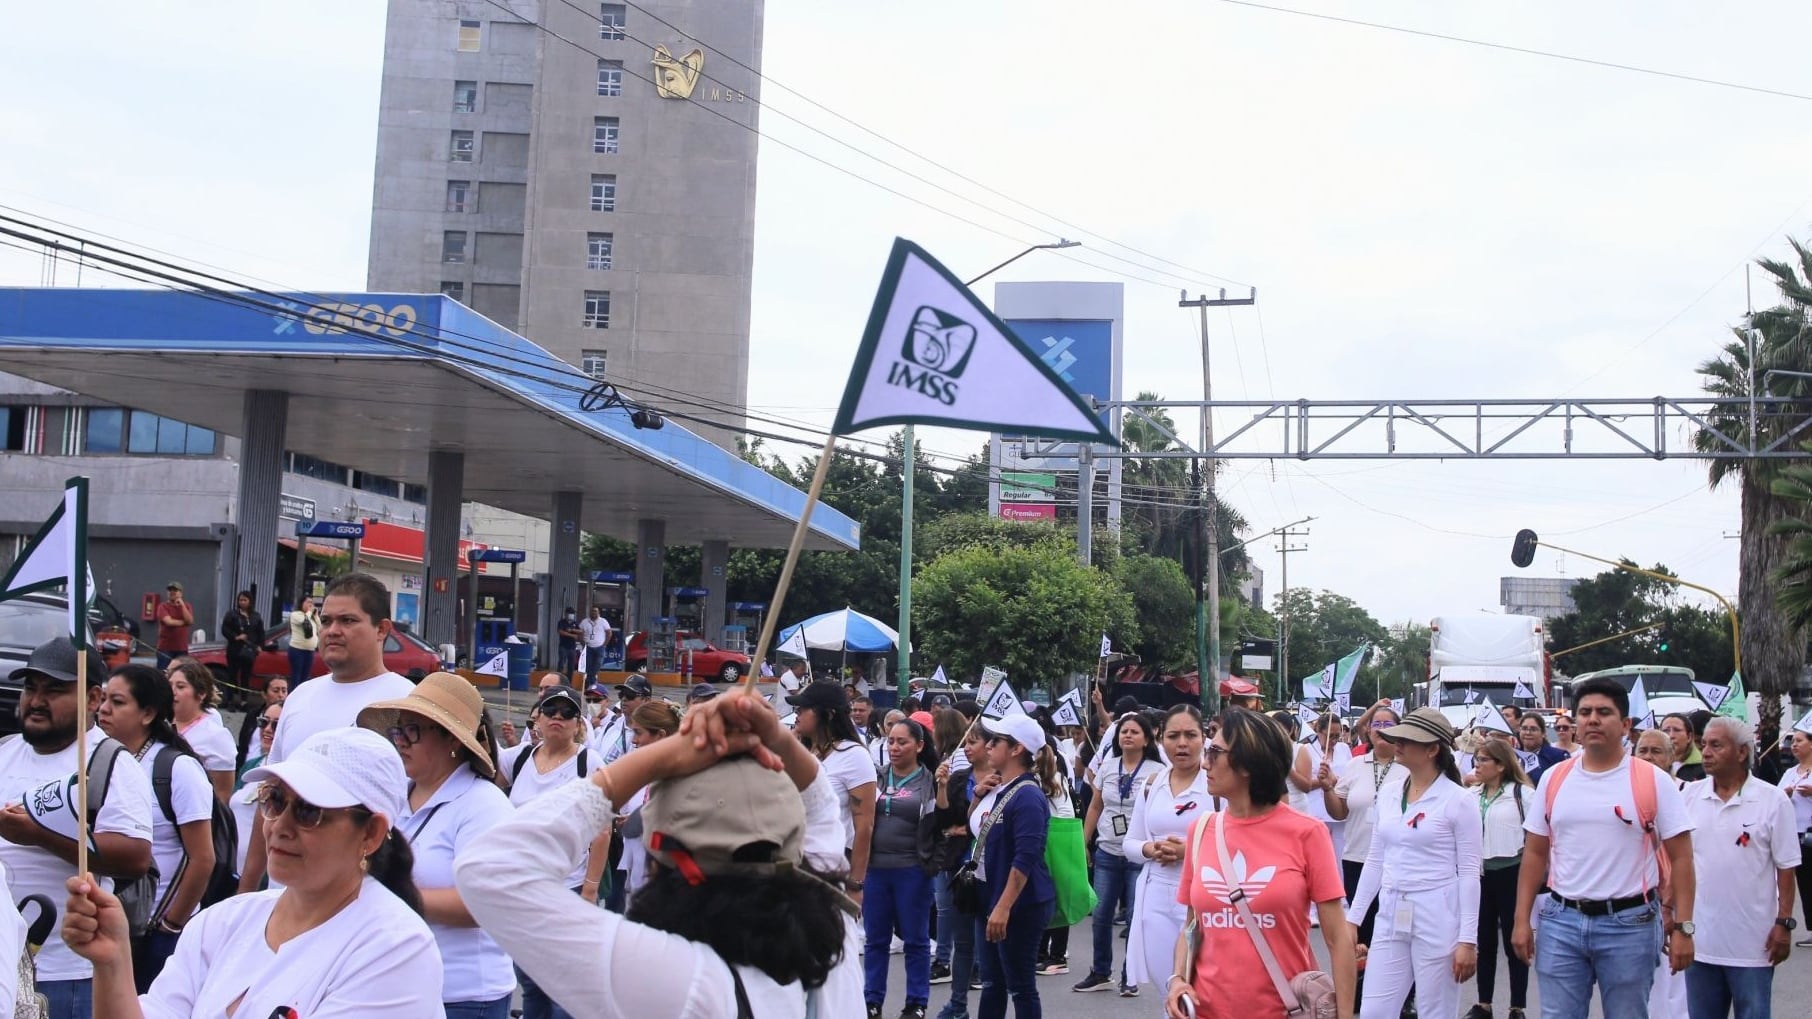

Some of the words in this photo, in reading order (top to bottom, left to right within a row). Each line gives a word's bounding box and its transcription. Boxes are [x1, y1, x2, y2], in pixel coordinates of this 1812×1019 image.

[702, 88, 745, 103] IMSS
[304, 303, 417, 336] G500
[886, 361, 959, 406] IMSS
[1003, 491, 1032, 500] Regular
[1011, 509, 1042, 517] Premium
